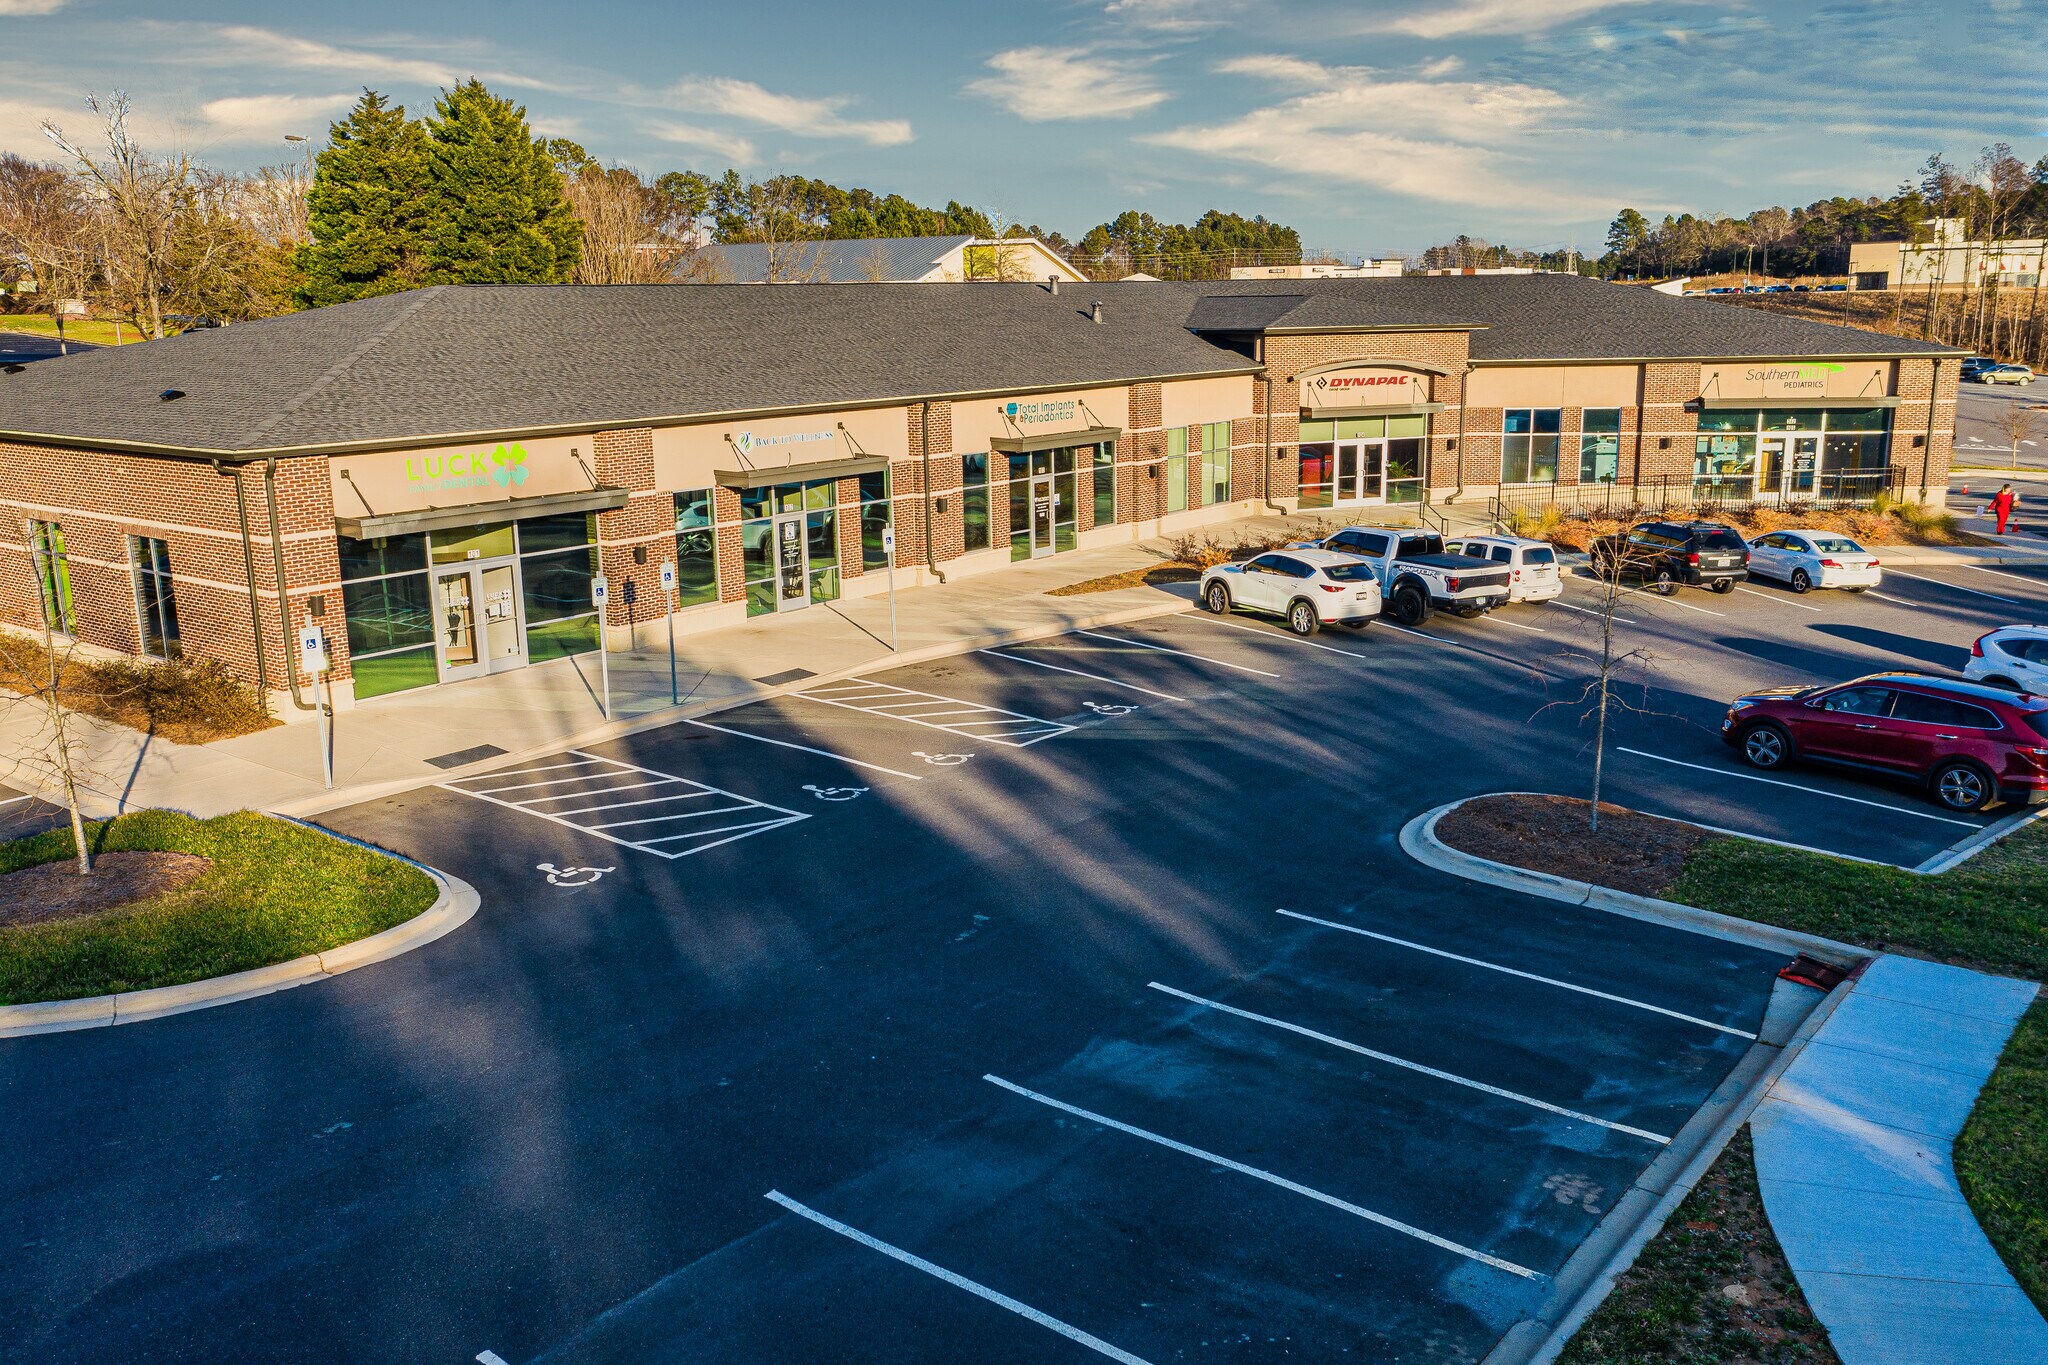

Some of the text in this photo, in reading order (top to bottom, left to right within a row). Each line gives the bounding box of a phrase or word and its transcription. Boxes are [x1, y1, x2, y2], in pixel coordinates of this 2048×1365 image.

[1329, 375, 1409, 387] DYNAPAC
[1745, 367, 1826, 381] SouthernMED
[1783, 381, 1824, 389] PEDIATRICS
[1018, 400, 1075, 414] Total Implants
[405, 451, 489, 481] LUCK
[442, 476, 490, 490] DENTAL
[468, 550, 480, 558] 101
[1399, 565, 1437, 579] RAPTOR
